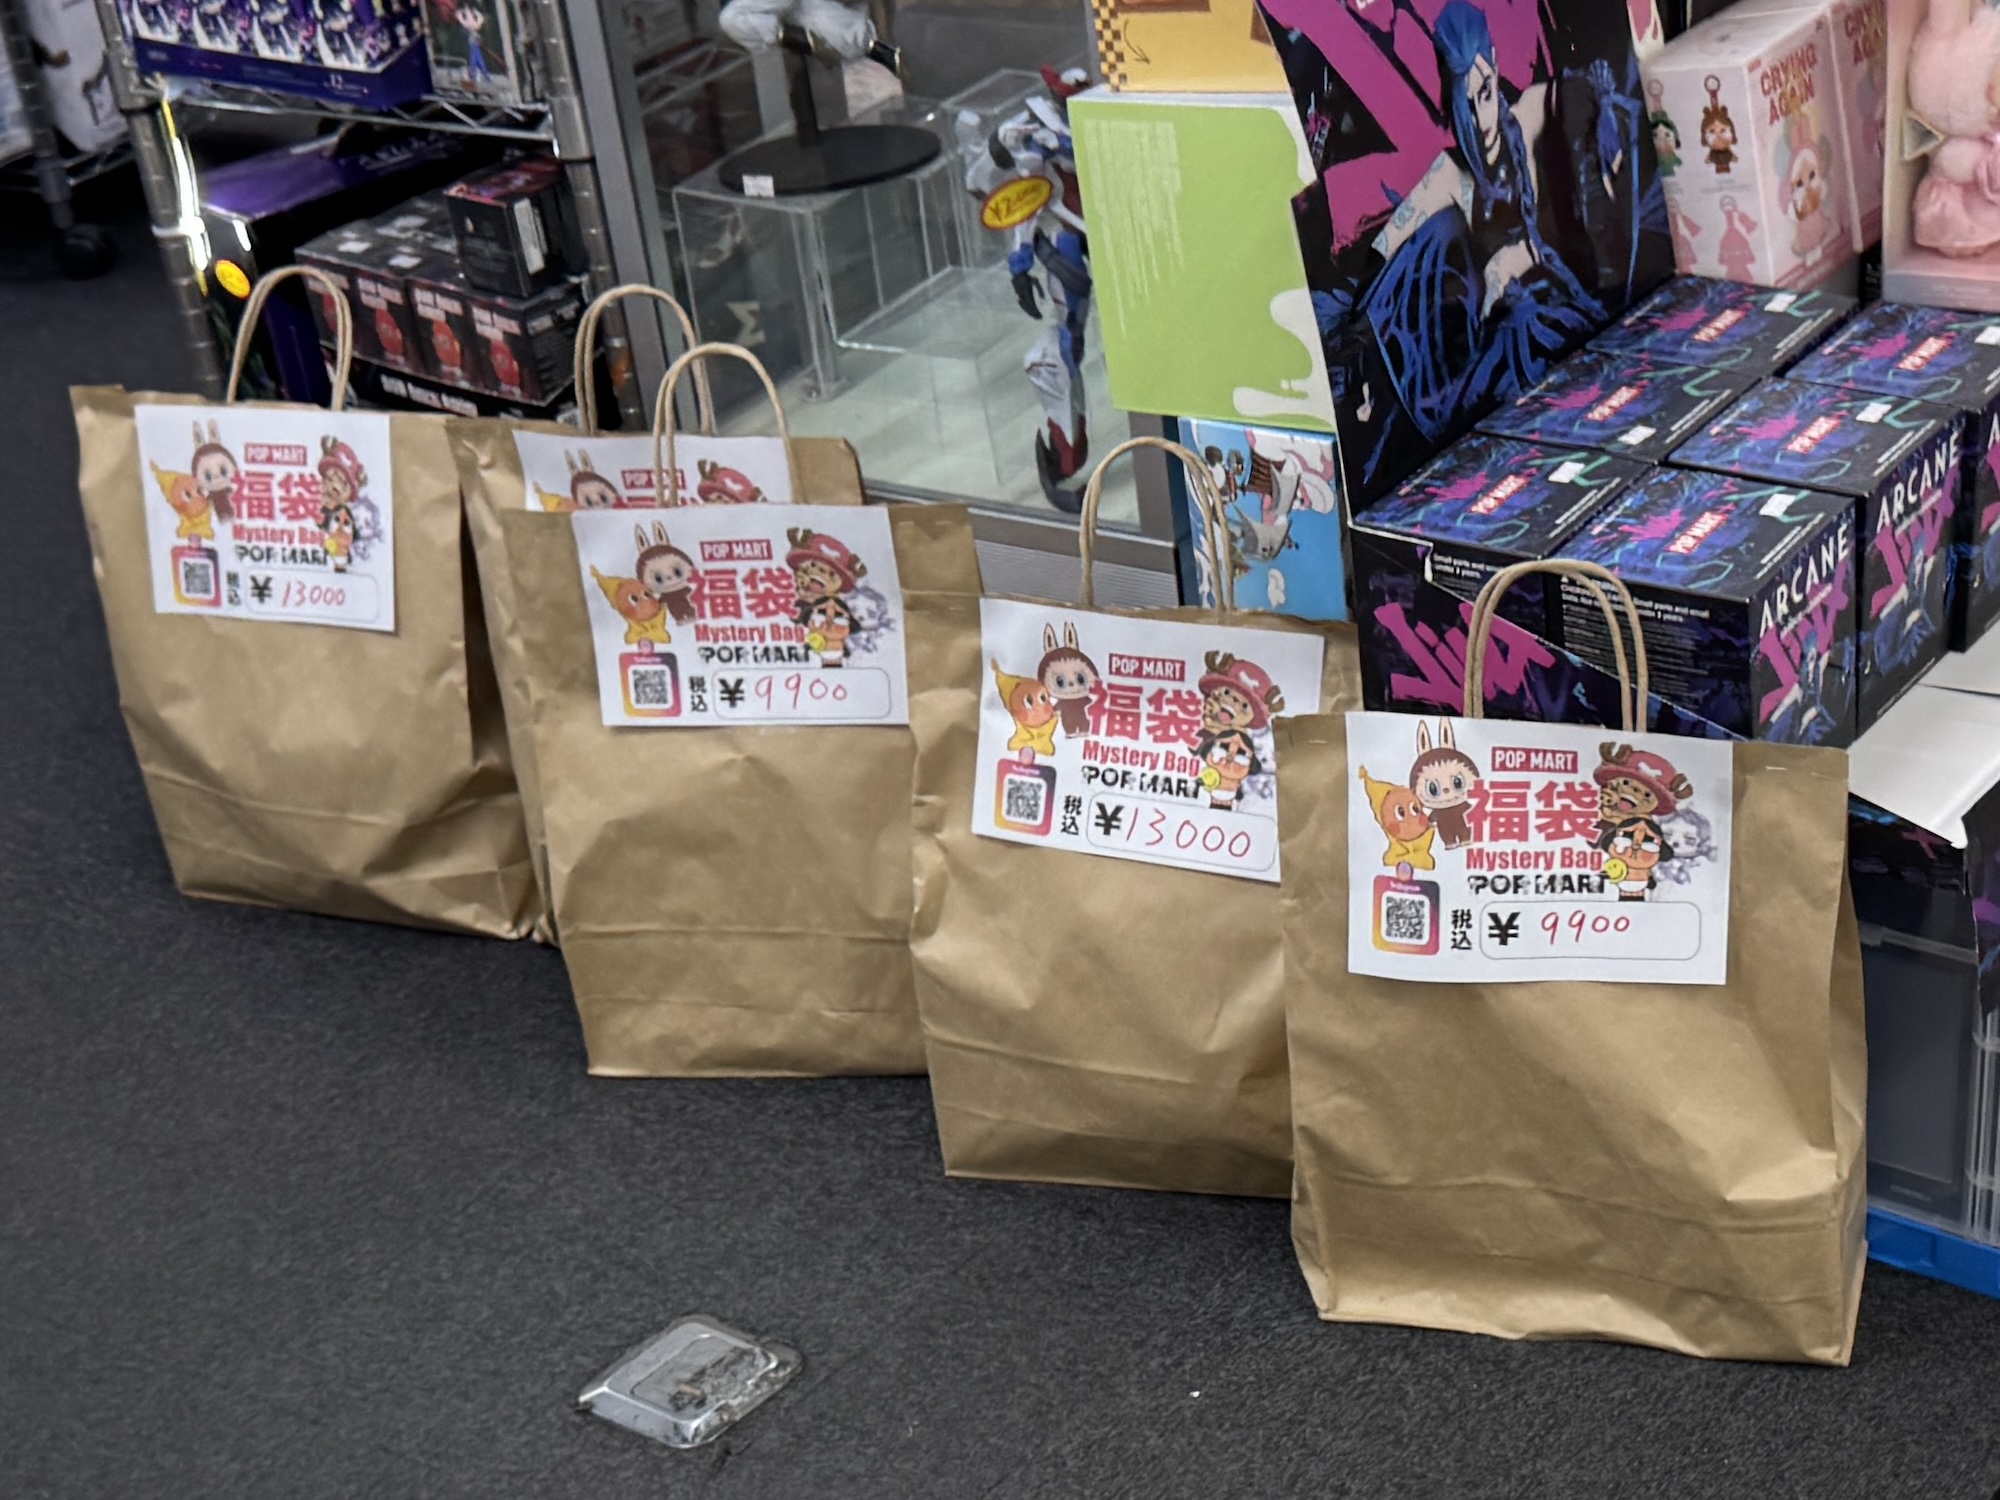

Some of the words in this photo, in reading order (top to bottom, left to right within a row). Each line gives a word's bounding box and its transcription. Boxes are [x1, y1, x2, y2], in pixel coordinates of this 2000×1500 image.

[248, 446, 270, 462] POP
[272, 449, 305, 464] MART
[230, 471, 326, 524] 福袋
[1876, 431, 1960, 534] ARCANE
[232, 524, 296, 545] Mystery
[703, 543, 733, 560] POP
[735, 541, 770, 559] MART
[281, 580, 346, 608] 13000
[687, 568, 800, 620] 福袋
[1760, 523, 1849, 638] ARCANE
[695, 624, 766, 647] Mystery
[770, 623, 806, 644] Bag
[1111, 656, 1139, 676] POP
[1142, 660, 1183, 681] MART
[689, 675, 708, 713] 税込
[754, 672, 848, 711] 9900
[1087, 682, 1205, 750] 福袋
[1082, 739, 1160, 771] Mystery
[1163, 752, 1201, 777] Bag
[1495, 750, 1527, 768] POP
[1530, 751, 1575, 770] MART
[1060, 794, 1082, 836] 税込
[1466, 779, 1603, 844] 福袋
[1125, 806, 1251, 858] 13000
[1466, 847, 1555, 873] Mystery
[1559, 848, 1603, 875] Bag
[1451, 909, 1473, 950] 税込
[1487, 911, 1521, 946] ¥
[1540, 909, 1631, 945] 9900
